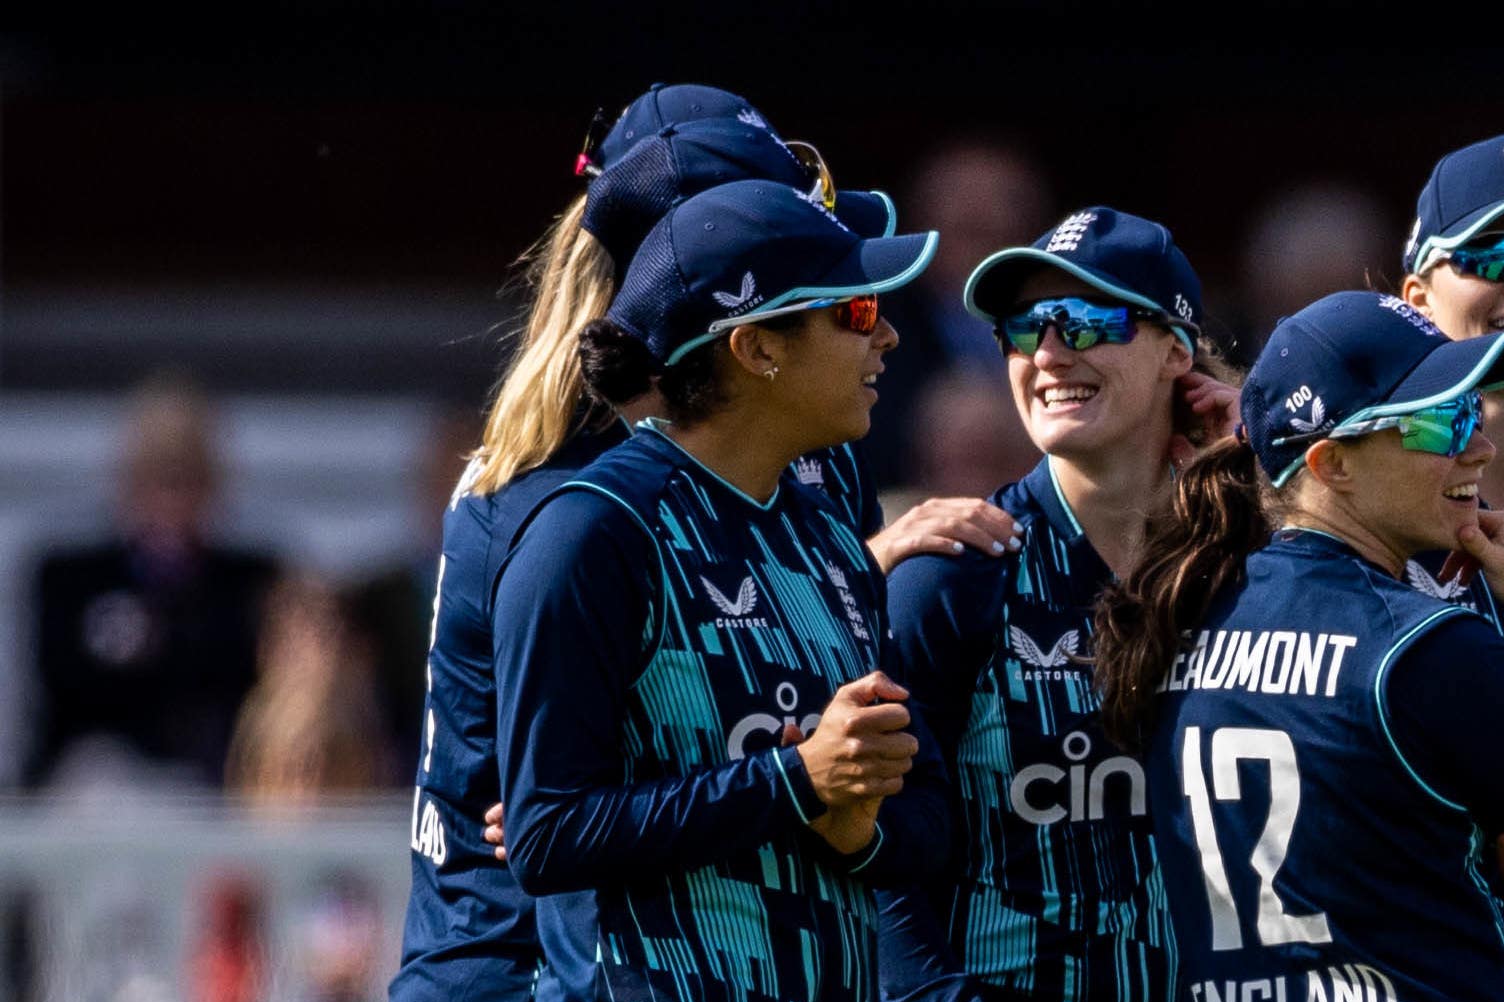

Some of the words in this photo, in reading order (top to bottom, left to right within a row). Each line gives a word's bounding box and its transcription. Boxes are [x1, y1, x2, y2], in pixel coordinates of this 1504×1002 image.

[1285, 385, 1312, 413] 100
[716, 617, 768, 628] CASTORE
[1015, 670, 1081, 681] CASTORE
[1181, 726, 1333, 951] 12
